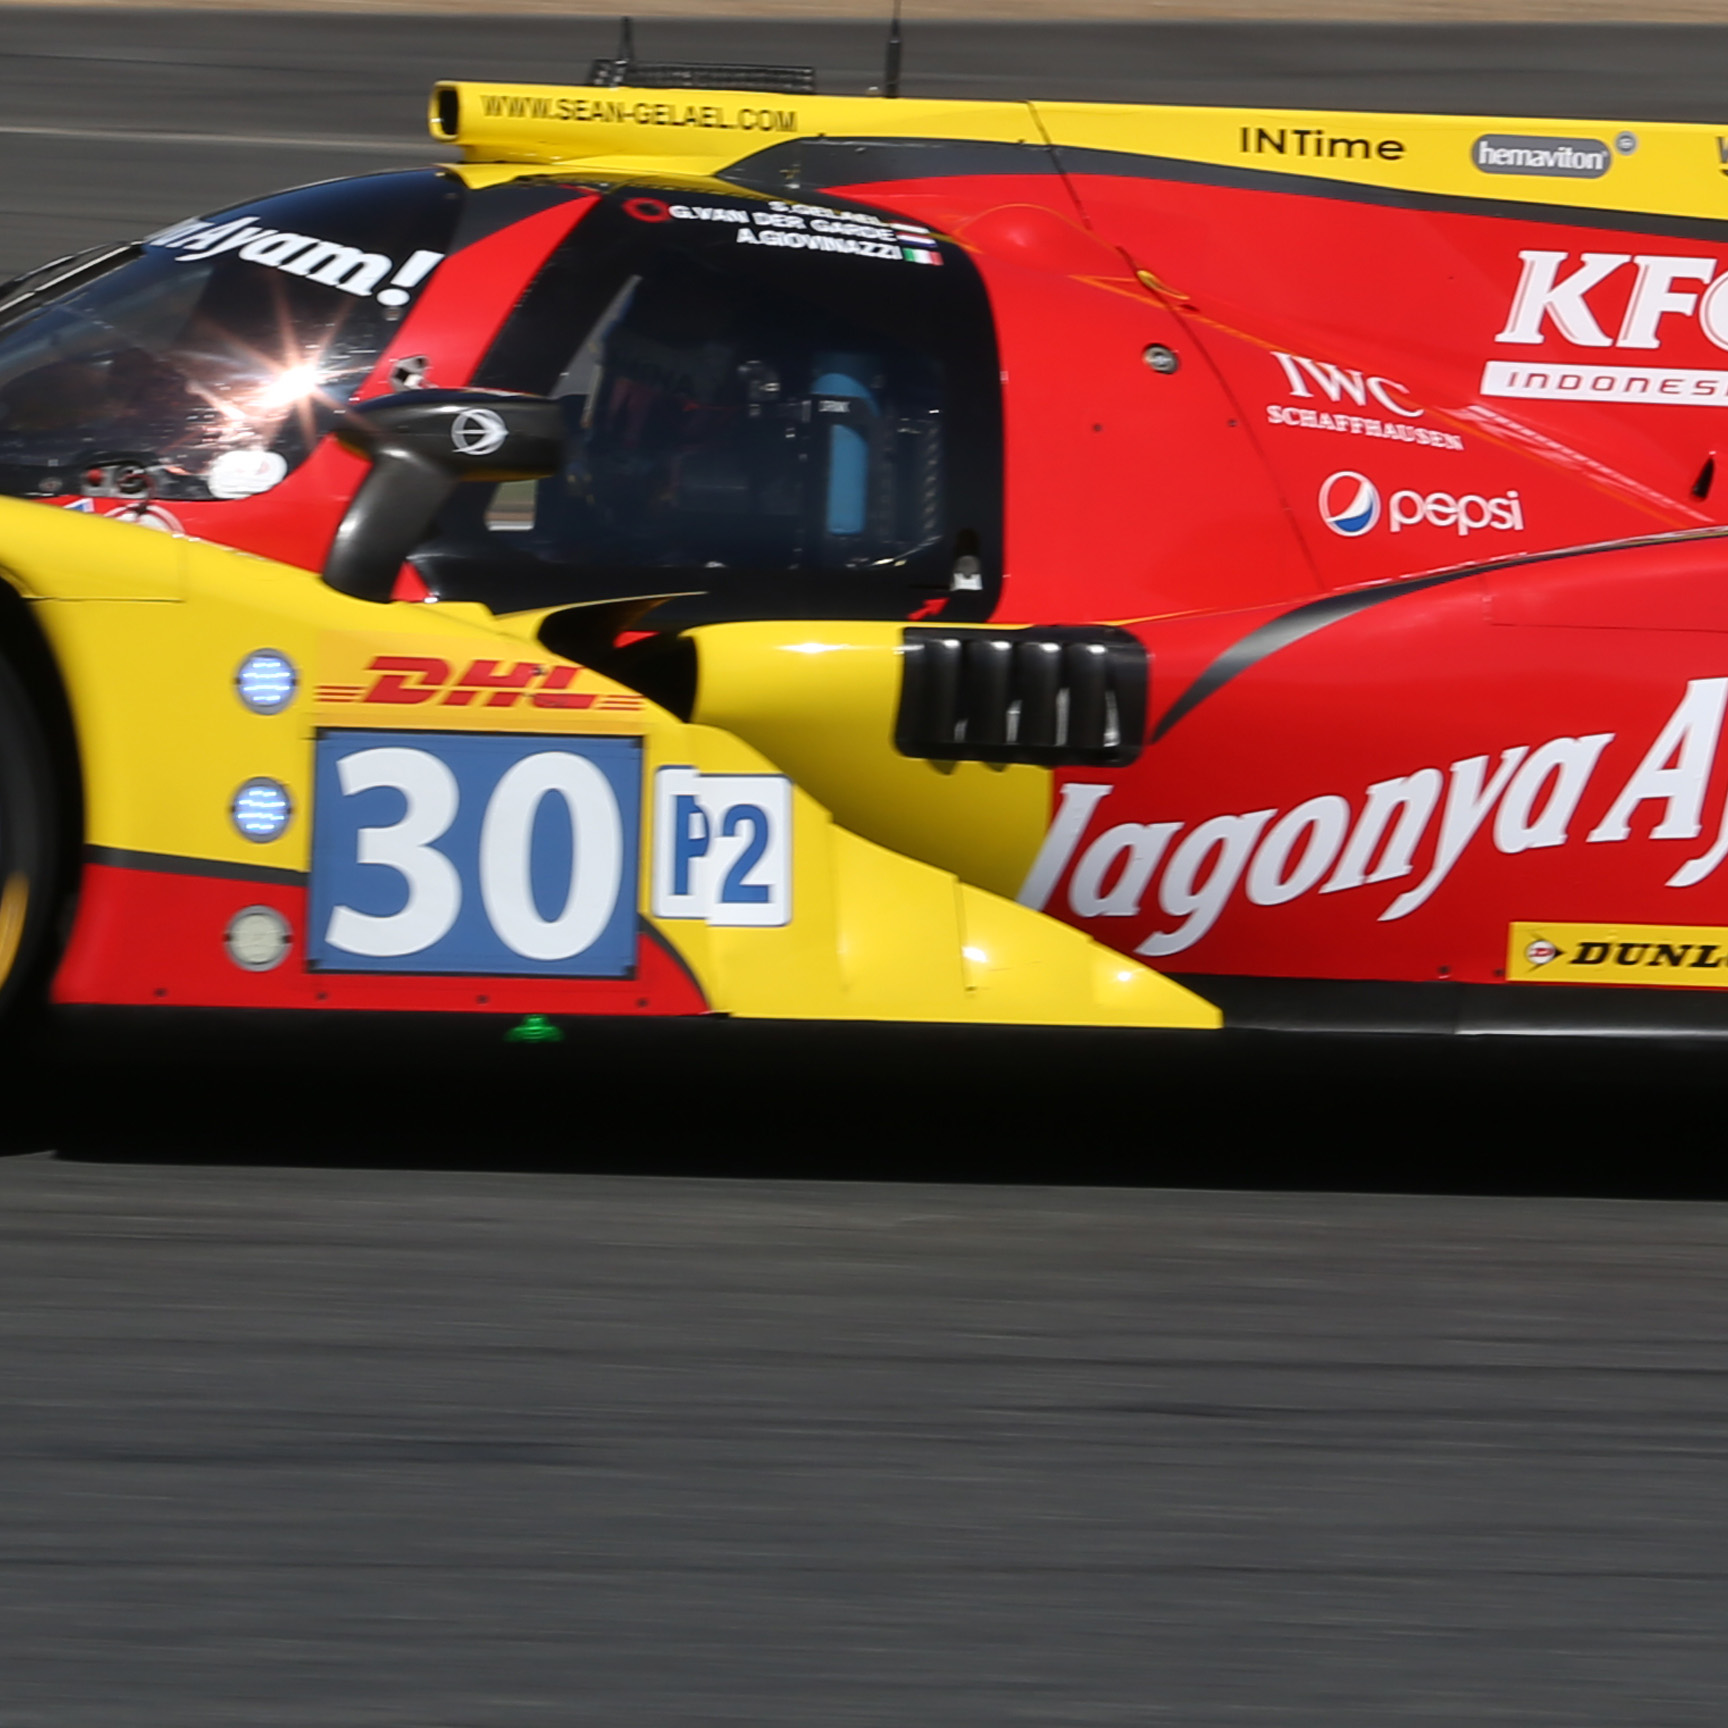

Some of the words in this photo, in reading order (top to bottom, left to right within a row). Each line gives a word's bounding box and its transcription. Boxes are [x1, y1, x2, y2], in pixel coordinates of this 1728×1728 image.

[480, 94, 799, 133] WWW.SEAN-GELAEL.COM
[1239, 126, 1406, 161] INTime
[1478, 140, 1604, 170] hemaviton
[810, 218, 898, 242] GARDE
[174, 215, 446, 307] Ayam!
[1270, 350, 1424, 417] IWC
[1266, 404, 1463, 451] SCHAFFHAUSEN
[1389, 490, 1525, 536] pepsi
[361, 655, 600, 710] DHL
[323, 746, 624, 962] 30
[672, 794, 772, 904] P2
